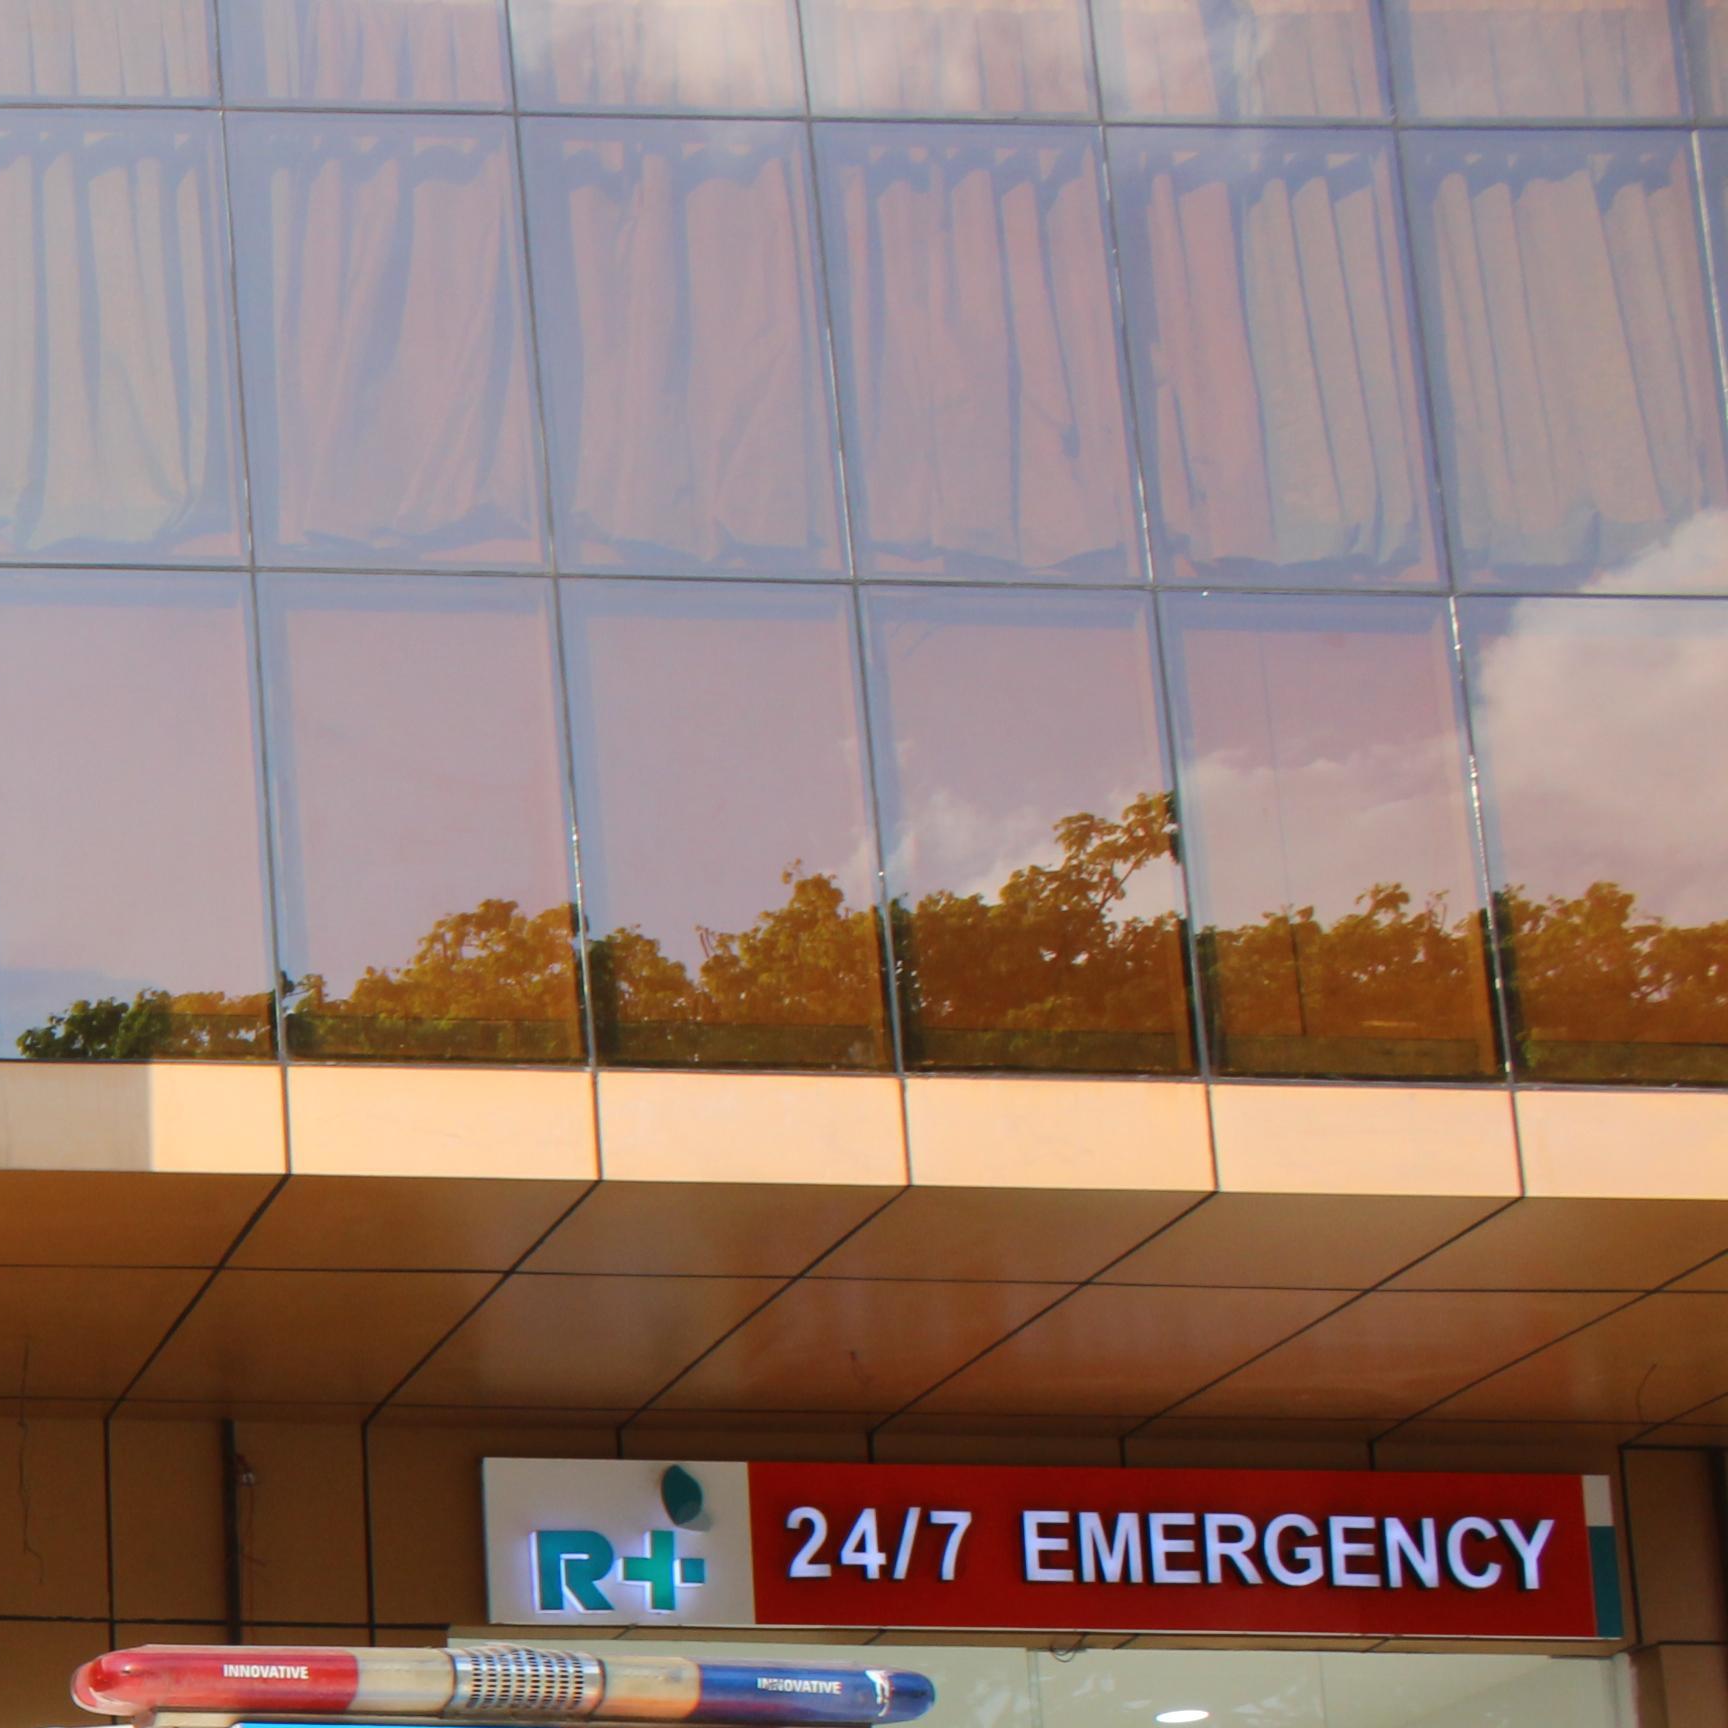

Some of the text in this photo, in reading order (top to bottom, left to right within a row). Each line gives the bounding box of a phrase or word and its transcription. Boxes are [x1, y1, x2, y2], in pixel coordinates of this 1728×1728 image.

[785, 1506, 1555, 1592] 24/7 EMERGENCY
[222, 1663, 310, 1681] INNOVATIVE
